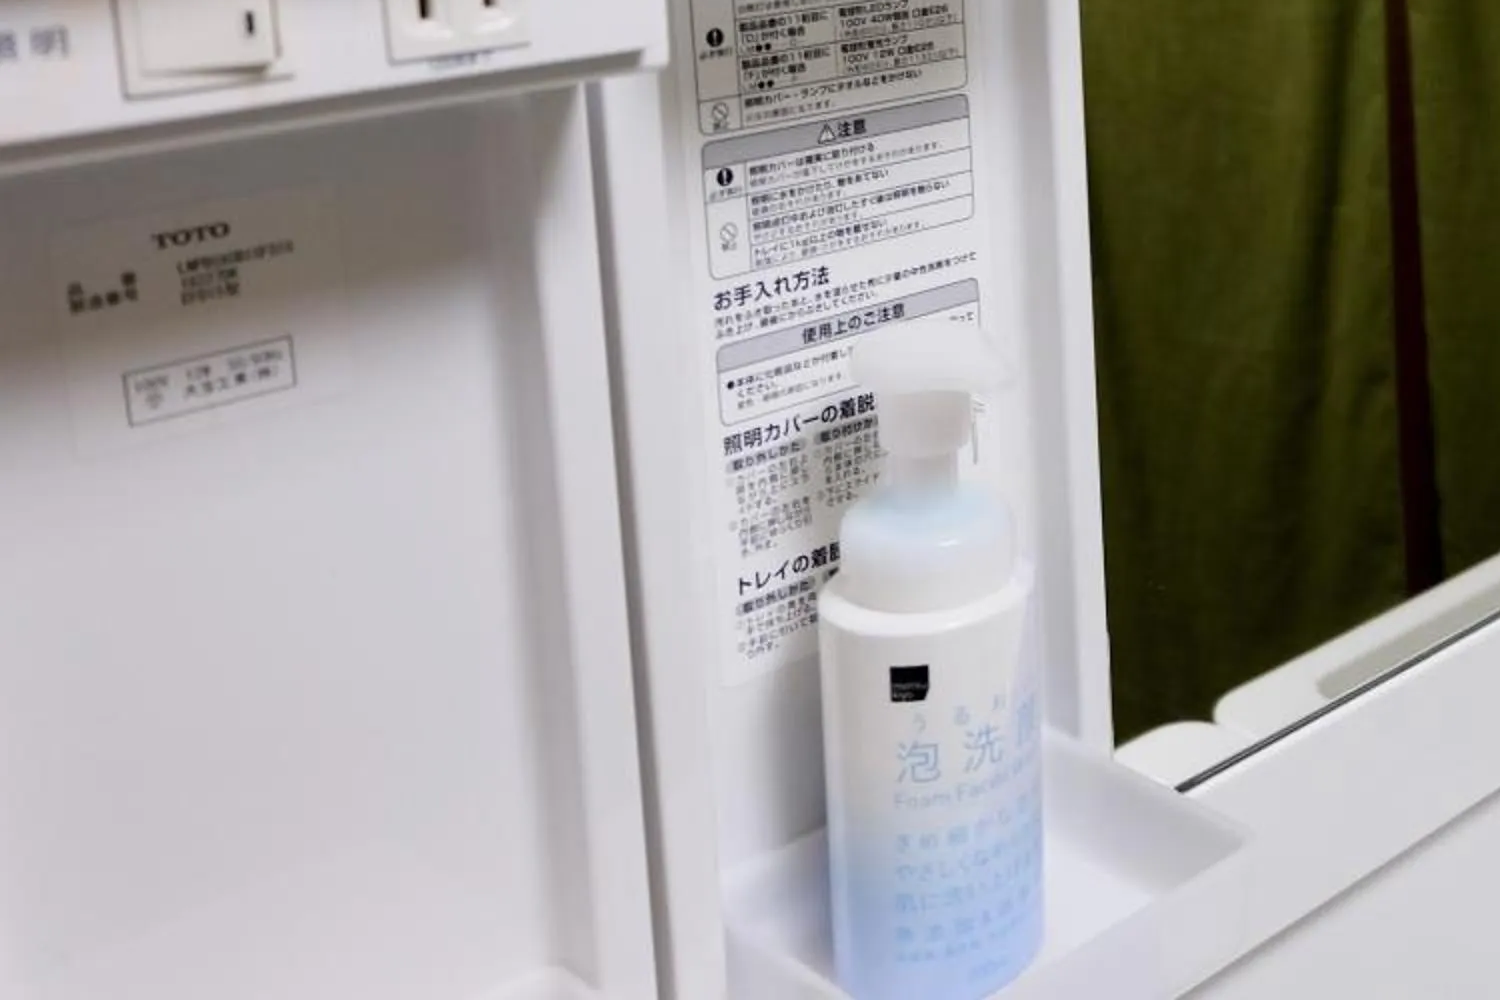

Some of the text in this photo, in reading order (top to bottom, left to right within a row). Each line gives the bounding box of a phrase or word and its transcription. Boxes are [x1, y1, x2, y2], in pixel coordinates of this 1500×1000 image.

[152, 222, 230, 250] TOTO
[713, 266, 831, 311] お手入れ方法
[802, 303, 906, 345] 使用上のご注意
[724, 393, 876, 457] 照明カバーの着脱
